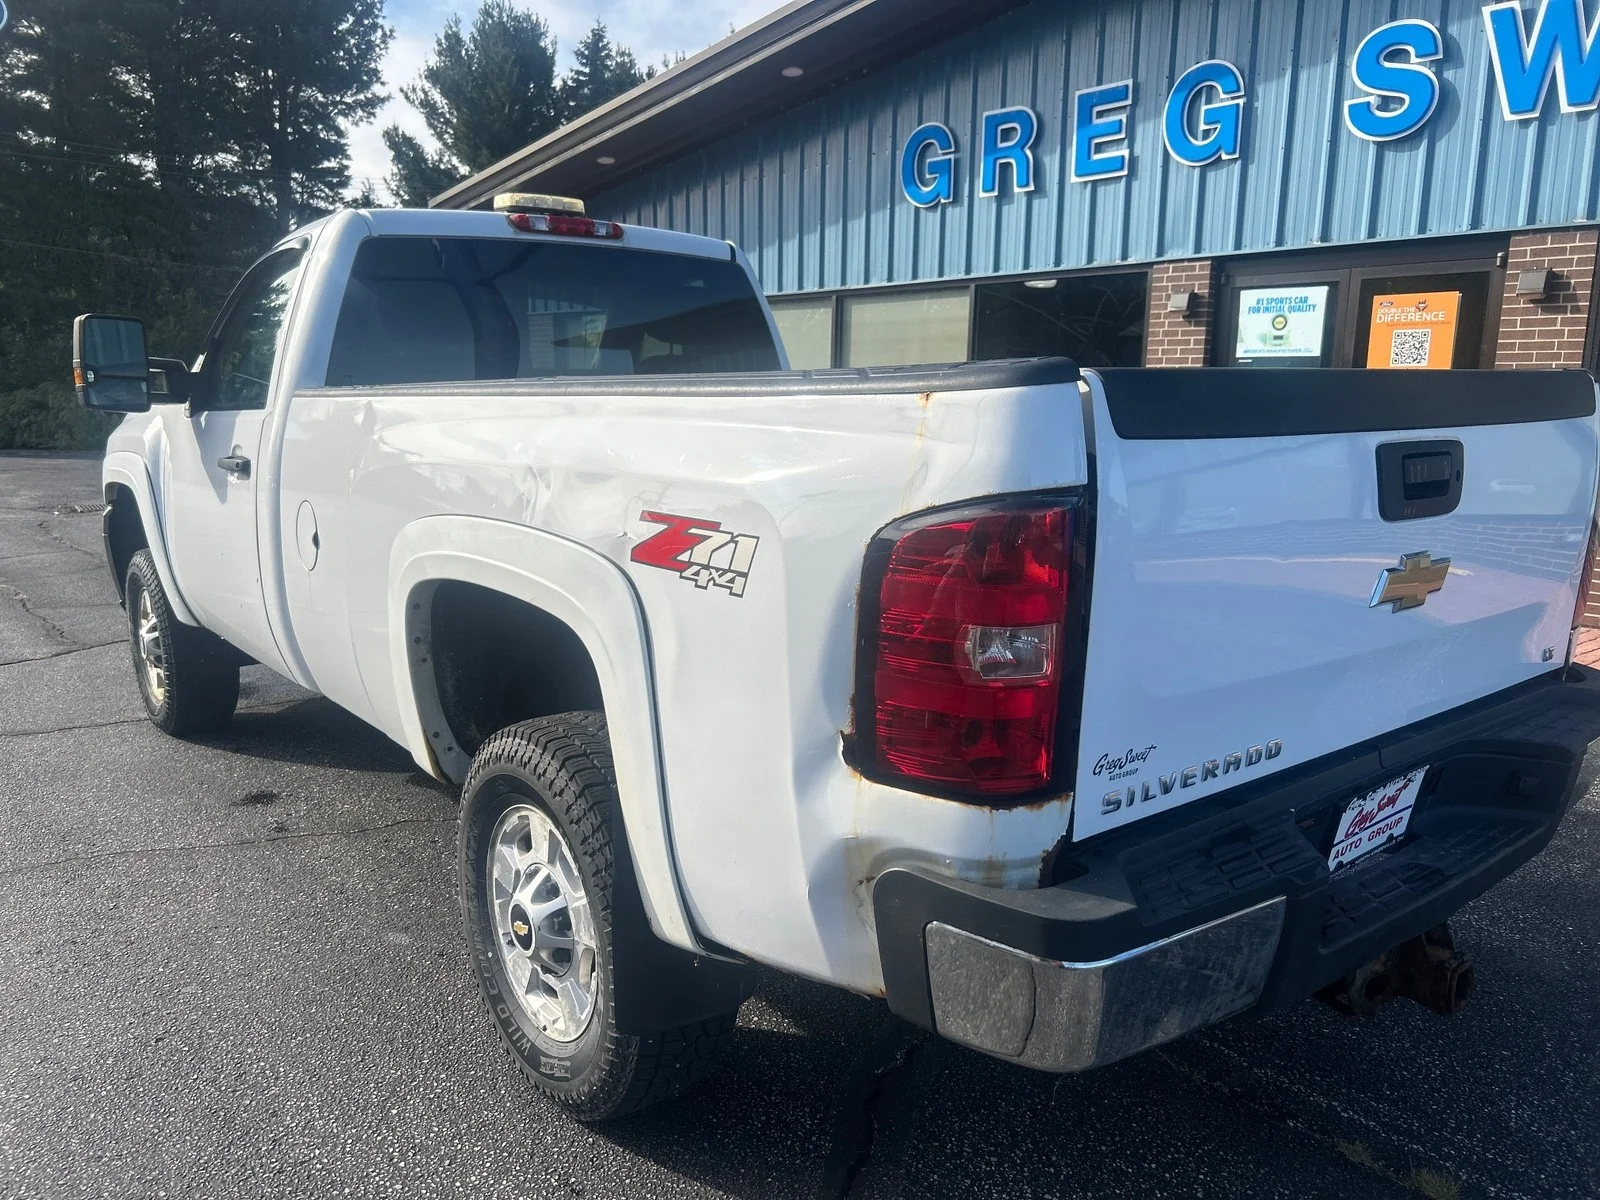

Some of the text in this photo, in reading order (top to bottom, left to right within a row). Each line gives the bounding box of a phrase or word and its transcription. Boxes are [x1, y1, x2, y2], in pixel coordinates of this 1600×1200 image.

[901, 0, 1600, 208] GREG SW
[1248, 303, 1317, 315] FOR INITIAL QUALITY
[1256, 296, 1309, 306] #1 SPORTS CAR
[1376, 311, 1446, 323] DIFFERENCE
[631, 509, 760, 573] Z71
[1092, 753, 1122, 776] Greg
[1101, 738, 1283, 815] SILVERADO
[1109, 768, 1139, 781] AUTO GROUP
[1332, 816, 1404, 861] AUTO GROUP
[496, 1002, 533, 1056] WILD
